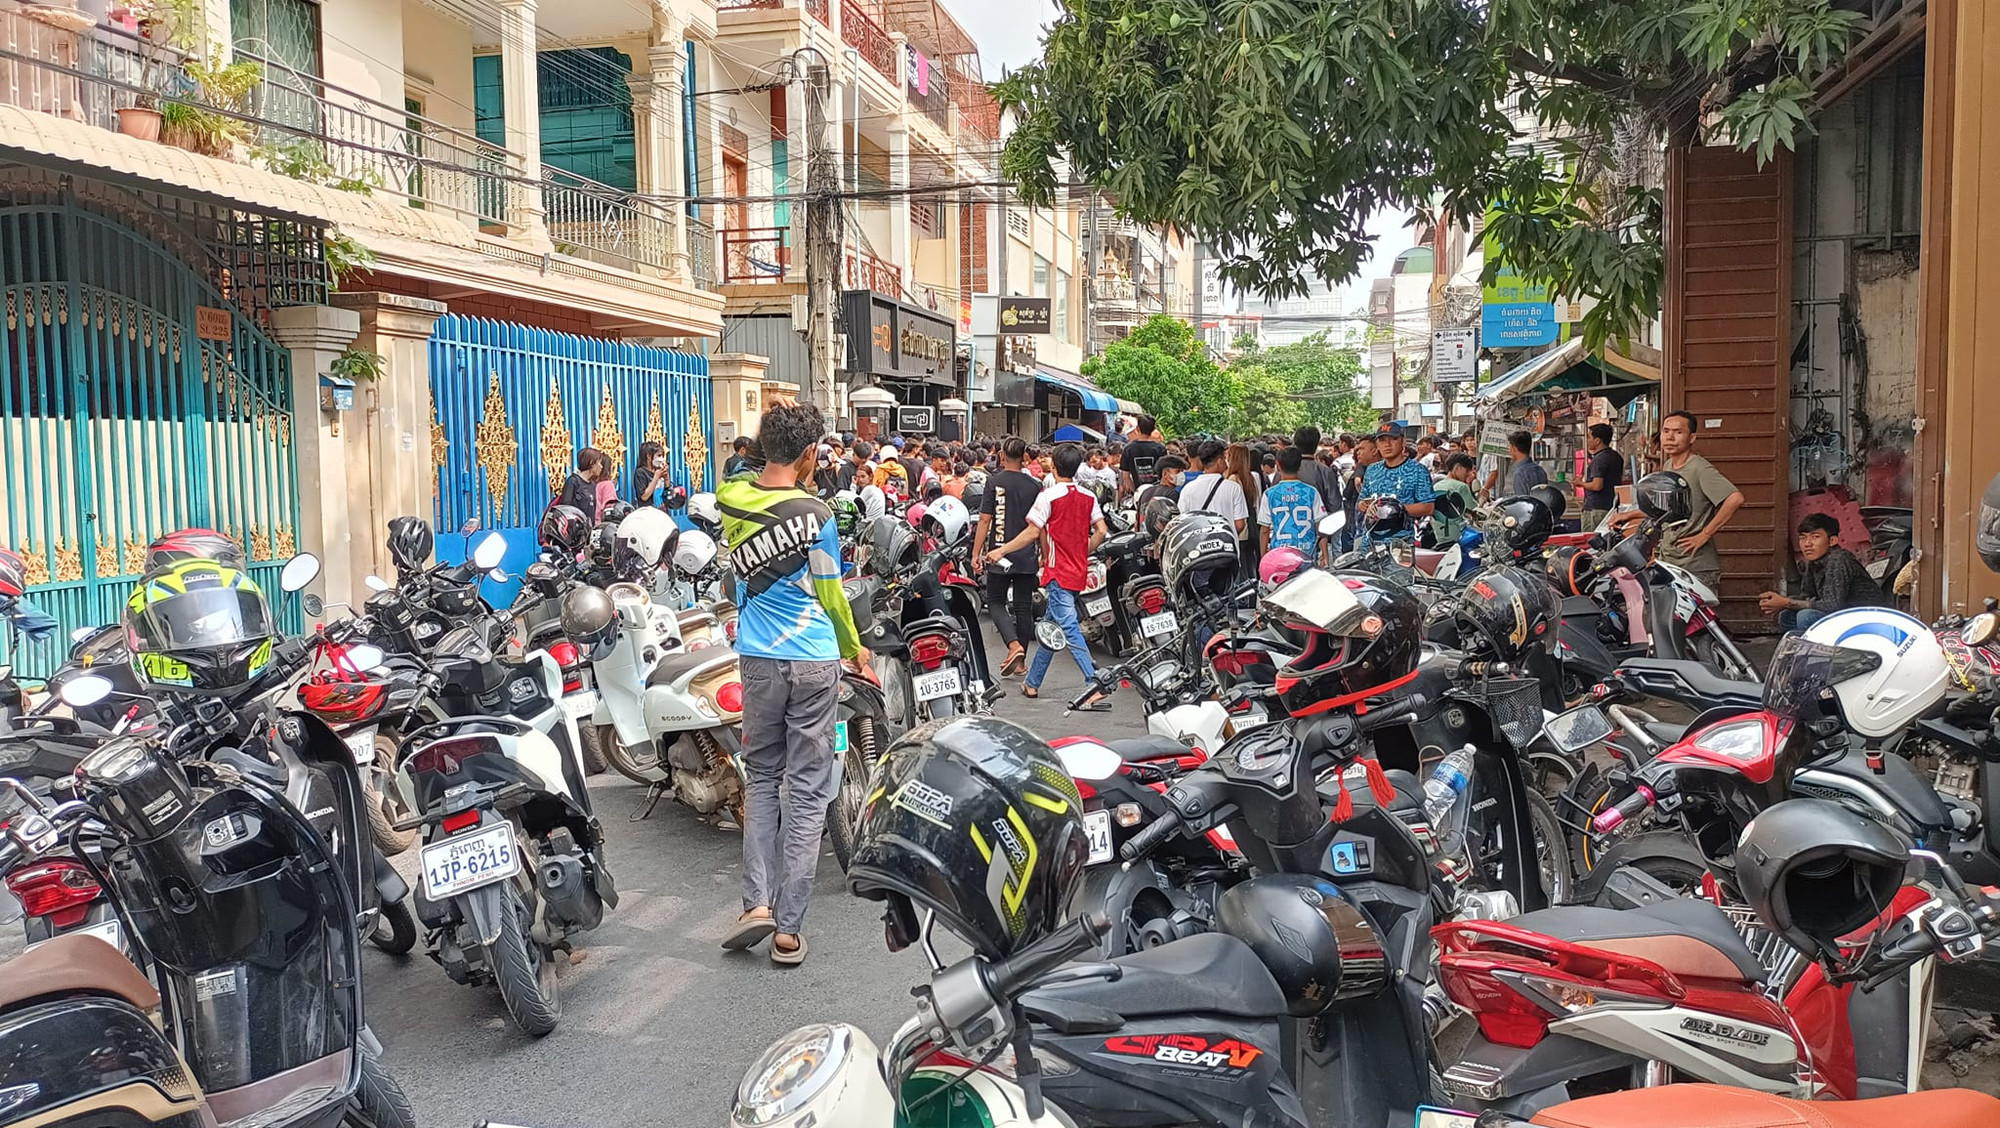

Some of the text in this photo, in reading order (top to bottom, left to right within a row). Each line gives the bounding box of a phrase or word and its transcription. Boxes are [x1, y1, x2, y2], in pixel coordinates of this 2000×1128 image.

[212, 325, 229, 337] 225
[1272, 505, 1312, 540] 29
[731, 512, 821, 575] YAMAHA
[1199, 540, 1222, 552] INDEX
[1896, 634, 1918, 658] SUZUKI
[919, 678, 957, 696] 1U-3765
[661, 714, 693, 722] SCOOPY
[1471, 797, 1498, 812] HONDA
[304, 806, 335, 821] HONDA
[452, 824, 478, 836] HONDA
[450, 838, 486, 861] ភ្នំពេញ
[430, 844, 511, 888] 1JP-6215
[452, 871, 495, 888] PHNOM PENH
[1161, 1068, 1198, 1078] Compact
[1460, 1061, 1501, 1072] HONDA
